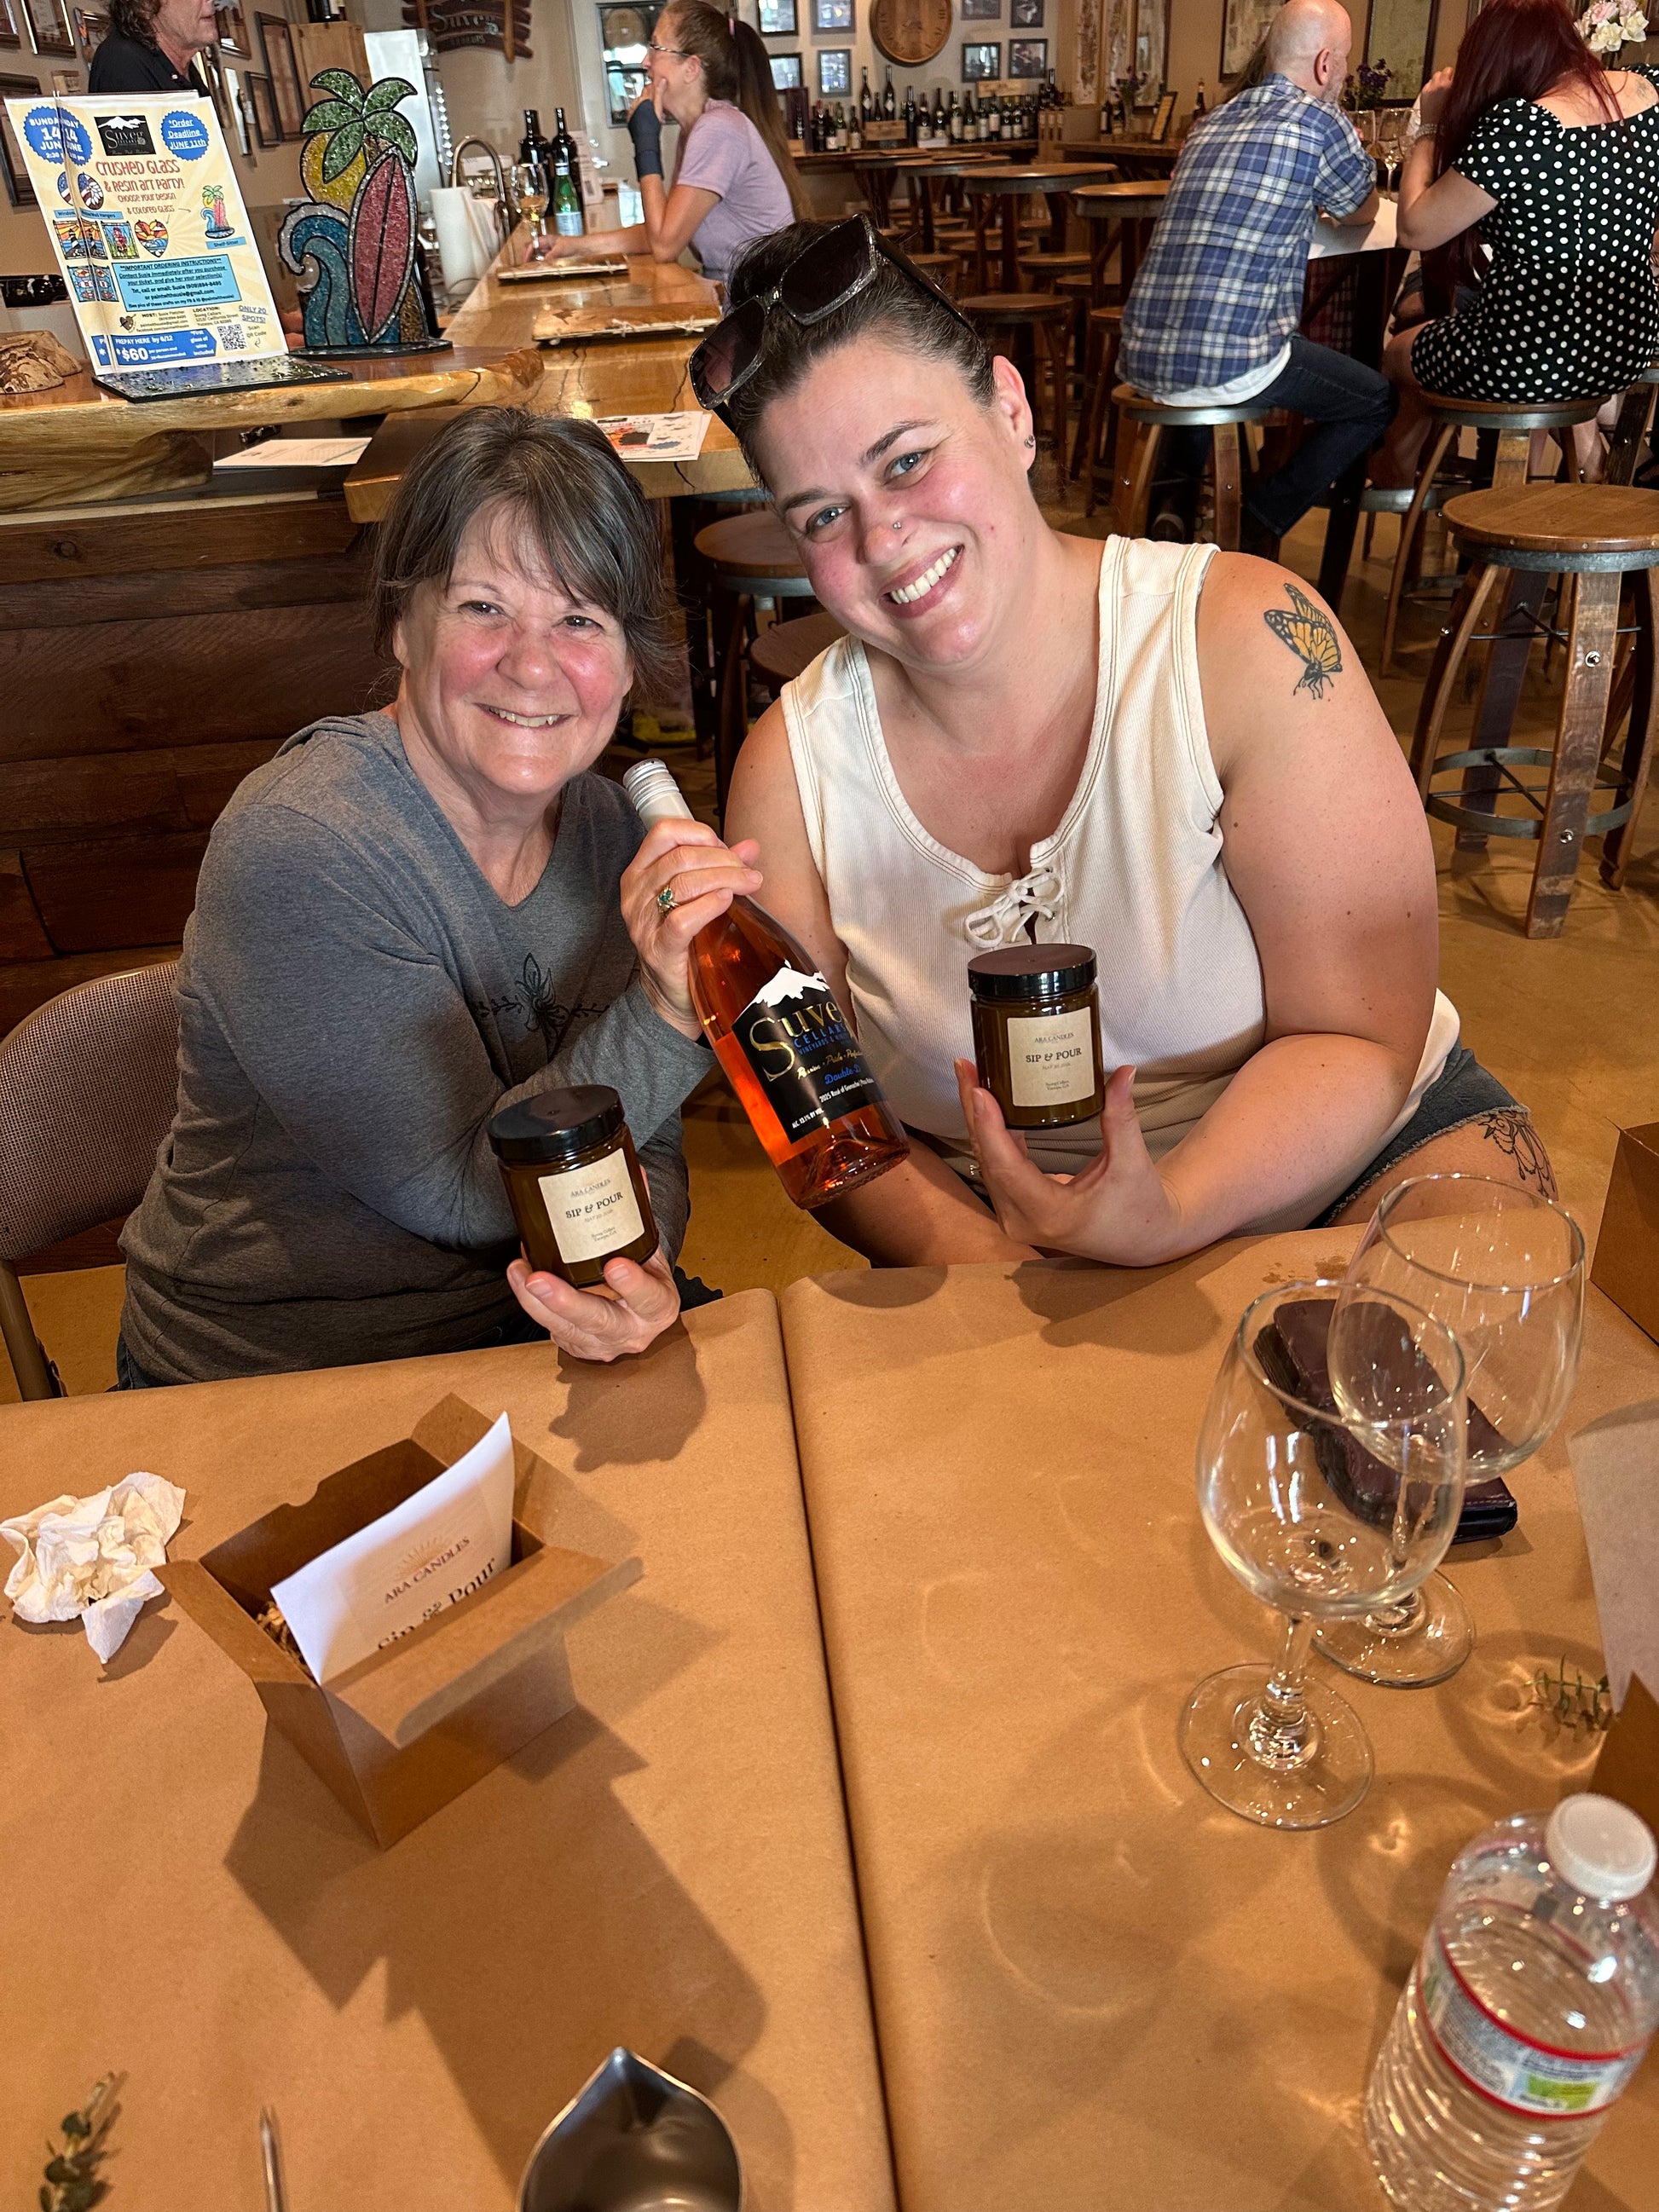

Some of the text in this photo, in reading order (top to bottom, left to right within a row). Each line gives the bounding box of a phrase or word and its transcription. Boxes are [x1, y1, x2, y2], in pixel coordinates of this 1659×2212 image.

[41, 126, 61, 141] 14
[167, 129, 201, 139] Deadline
[170, 138, 207, 150] JUNE 11th
[103, 181, 113, 193] &
[153, 261, 181, 269] ORDERING
[151, 269, 182, 278] immediately
[239, 304, 257, 314] ONLY
[749, 1002, 844, 1083] Suve
[793, 1023, 847, 1048] CELLARS
[797, 1037, 829, 1055] VINEYARDS
[1026, 1047, 1083, 1063] SIP & POUR
[565, 1191, 624, 1219] SIP & POUR
[385, 1536, 471, 1604] ARA CANDLES
